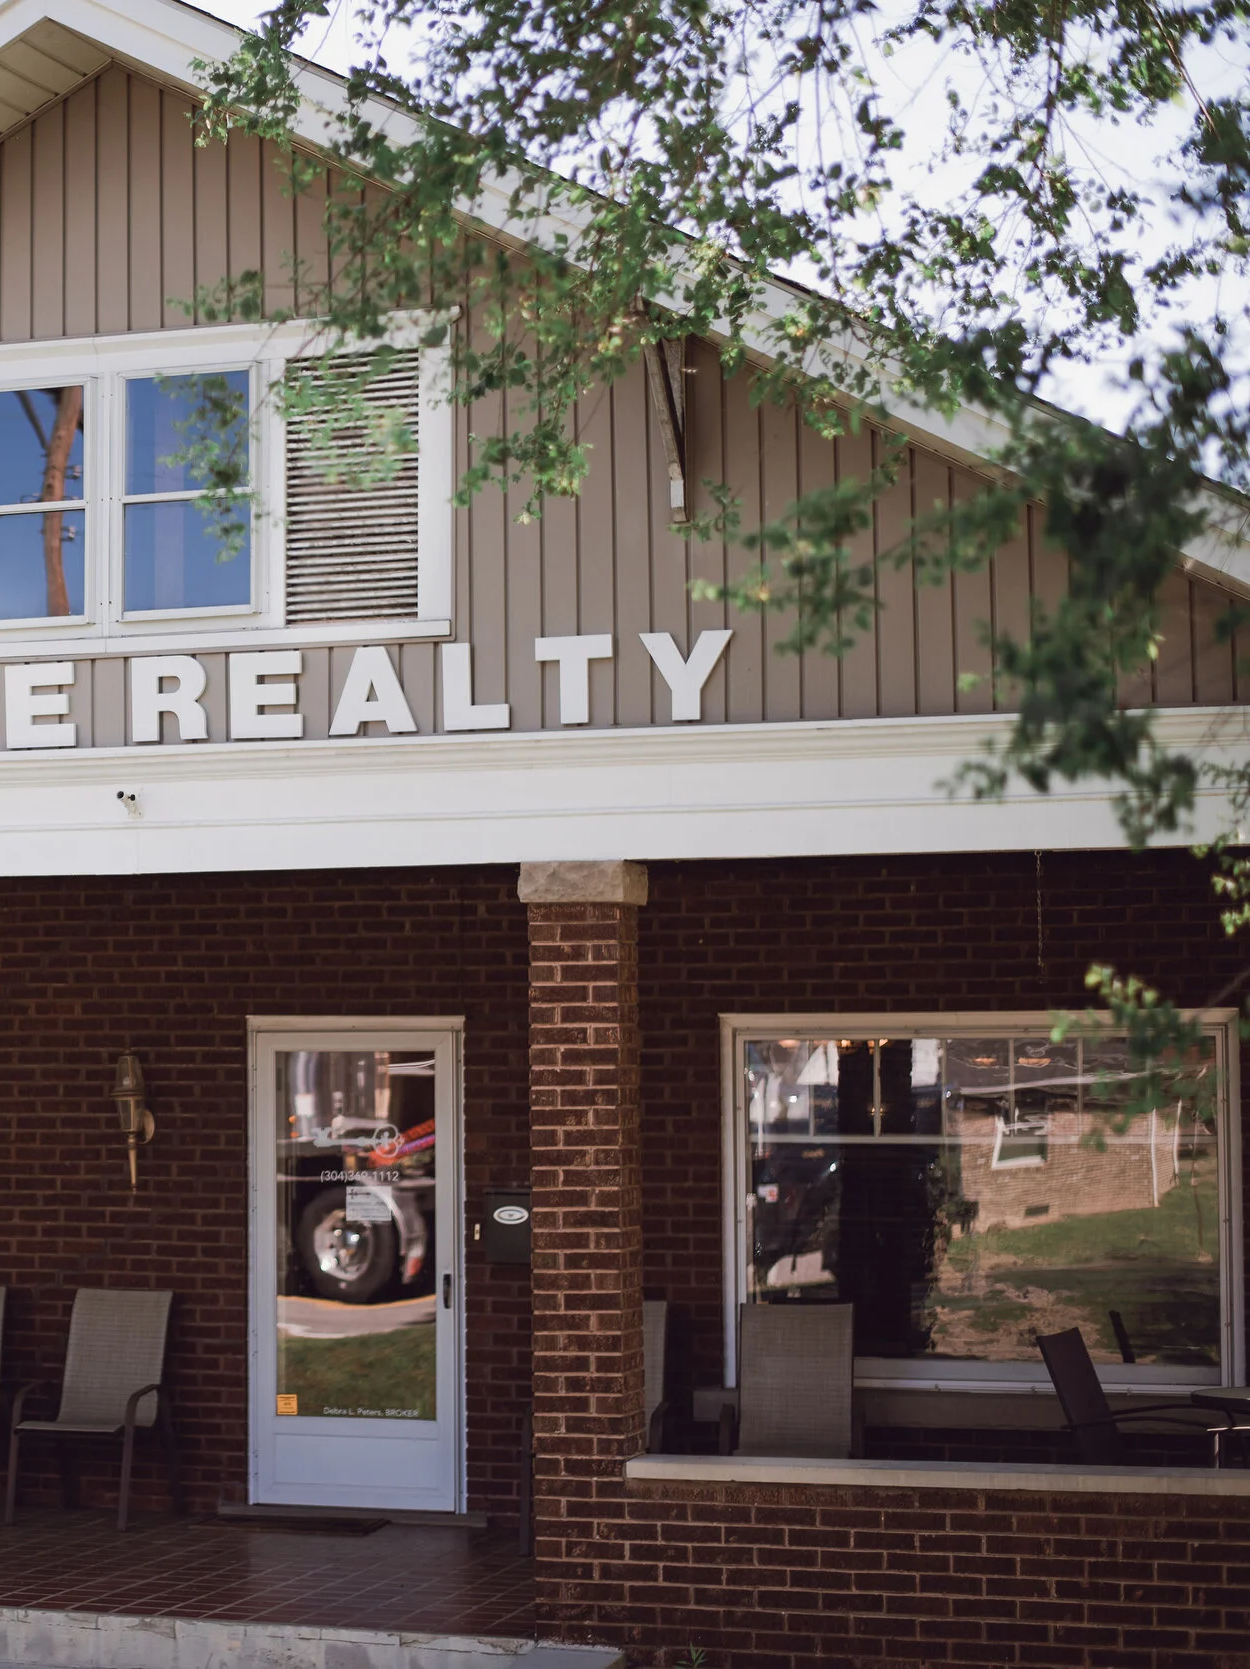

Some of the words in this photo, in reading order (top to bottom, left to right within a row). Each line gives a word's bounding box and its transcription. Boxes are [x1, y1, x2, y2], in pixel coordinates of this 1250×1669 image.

[129, 629, 735, 744] REALTY
[323, 1406, 347, 1415] Debra
[385, 1408, 419, 1418] BROKER
